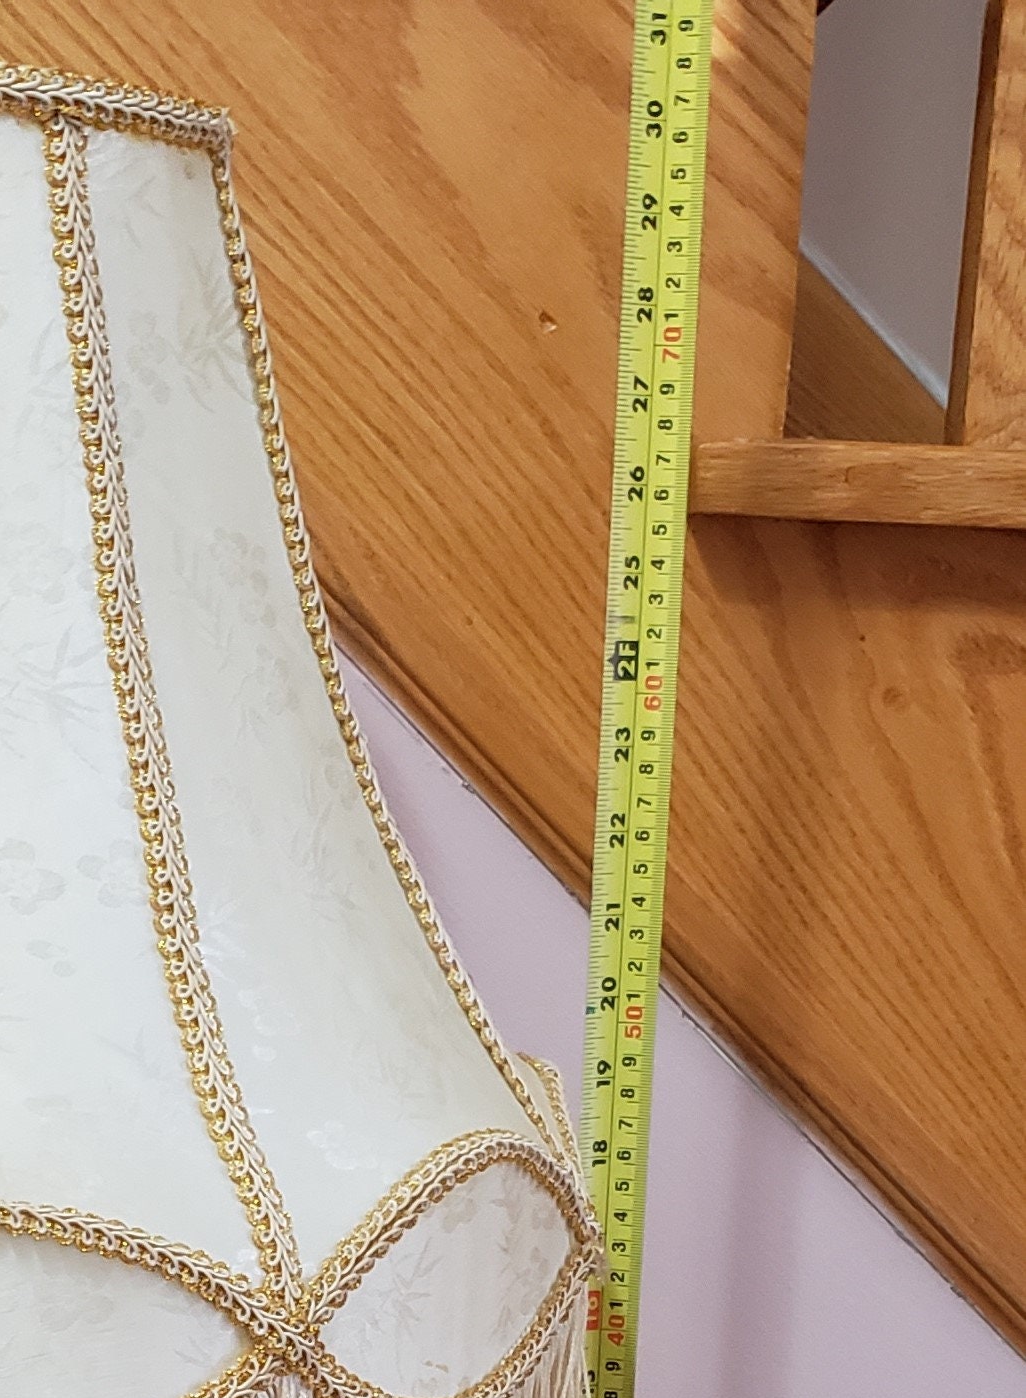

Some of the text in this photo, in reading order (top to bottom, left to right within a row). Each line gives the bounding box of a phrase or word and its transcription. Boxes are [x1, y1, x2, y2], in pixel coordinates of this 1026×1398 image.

[651, 13, 667, 45] 31
[678, 20, 694, 32] 9
[676, 57, 691, 69] 8
[674, 95, 690, 105] 7
[646, 101, 663, 138] 30
[672, 131, 688, 143] 6
[671, 168, 686, 179] 5
[641, 193, 658, 230] 29
[669, 205, 684, 216] 4
[667, 241, 682, 252] 3
[666, 277, 680, 288] 2
[637, 287, 654, 322] 28
[664, 313, 678, 321] 1
[663, 327, 682, 363] 70
[633, 376, 649, 412] 27
[660, 384, 675, 394] 9
[658, 419, 673, 430] 8
[656, 455, 670, 465] 7
[628, 466, 644, 502] 26
[654, 490, 669, 500] 6
[652, 524, 667, 535] 5
[651, 560, 665, 570] 4
[624, 555, 640, 590] 25
[649, 594, 663, 605] 3
[647, 628, 661, 639] 2
[646, 661, 660, 670] 1
[644, 676, 663, 711] 60
[641, 730, 655, 741] 9
[614, 727, 630, 762] 23
[639, 764, 653, 774] 8
[637, 797, 652, 807] 7
[609, 813, 625, 848] 22
[635, 830, 650, 841] 6
[633, 864, 648, 874] 5
[632, 897, 646, 907] 4
[605, 903, 620, 931] 21
[629, 929, 644, 940] 3
[628, 961, 642, 972] 2
[600, 977, 617, 1011] 20
[626, 993, 640, 1001] 1
[625, 1006, 643, 1039] 50
[622, 1057, 636, 1067] 9
[596, 1060, 611, 1088] 19
[621, 1088, 634, 1098] 8
[619, 1120, 633, 1130] 7
[592, 1140, 607, 1167] 18
[617, 1150, 631, 1160] 6
[615, 1181, 629, 1191] 5
[614, 1212, 627, 1222] 4
[612, 1242, 626, 1252] 3
[611, 1272, 625, 1283] 2
[609, 1301, 623, 1310] 1
[608, 1315, 625, 1345] 40
[605, 1361, 621, 1371] 9
